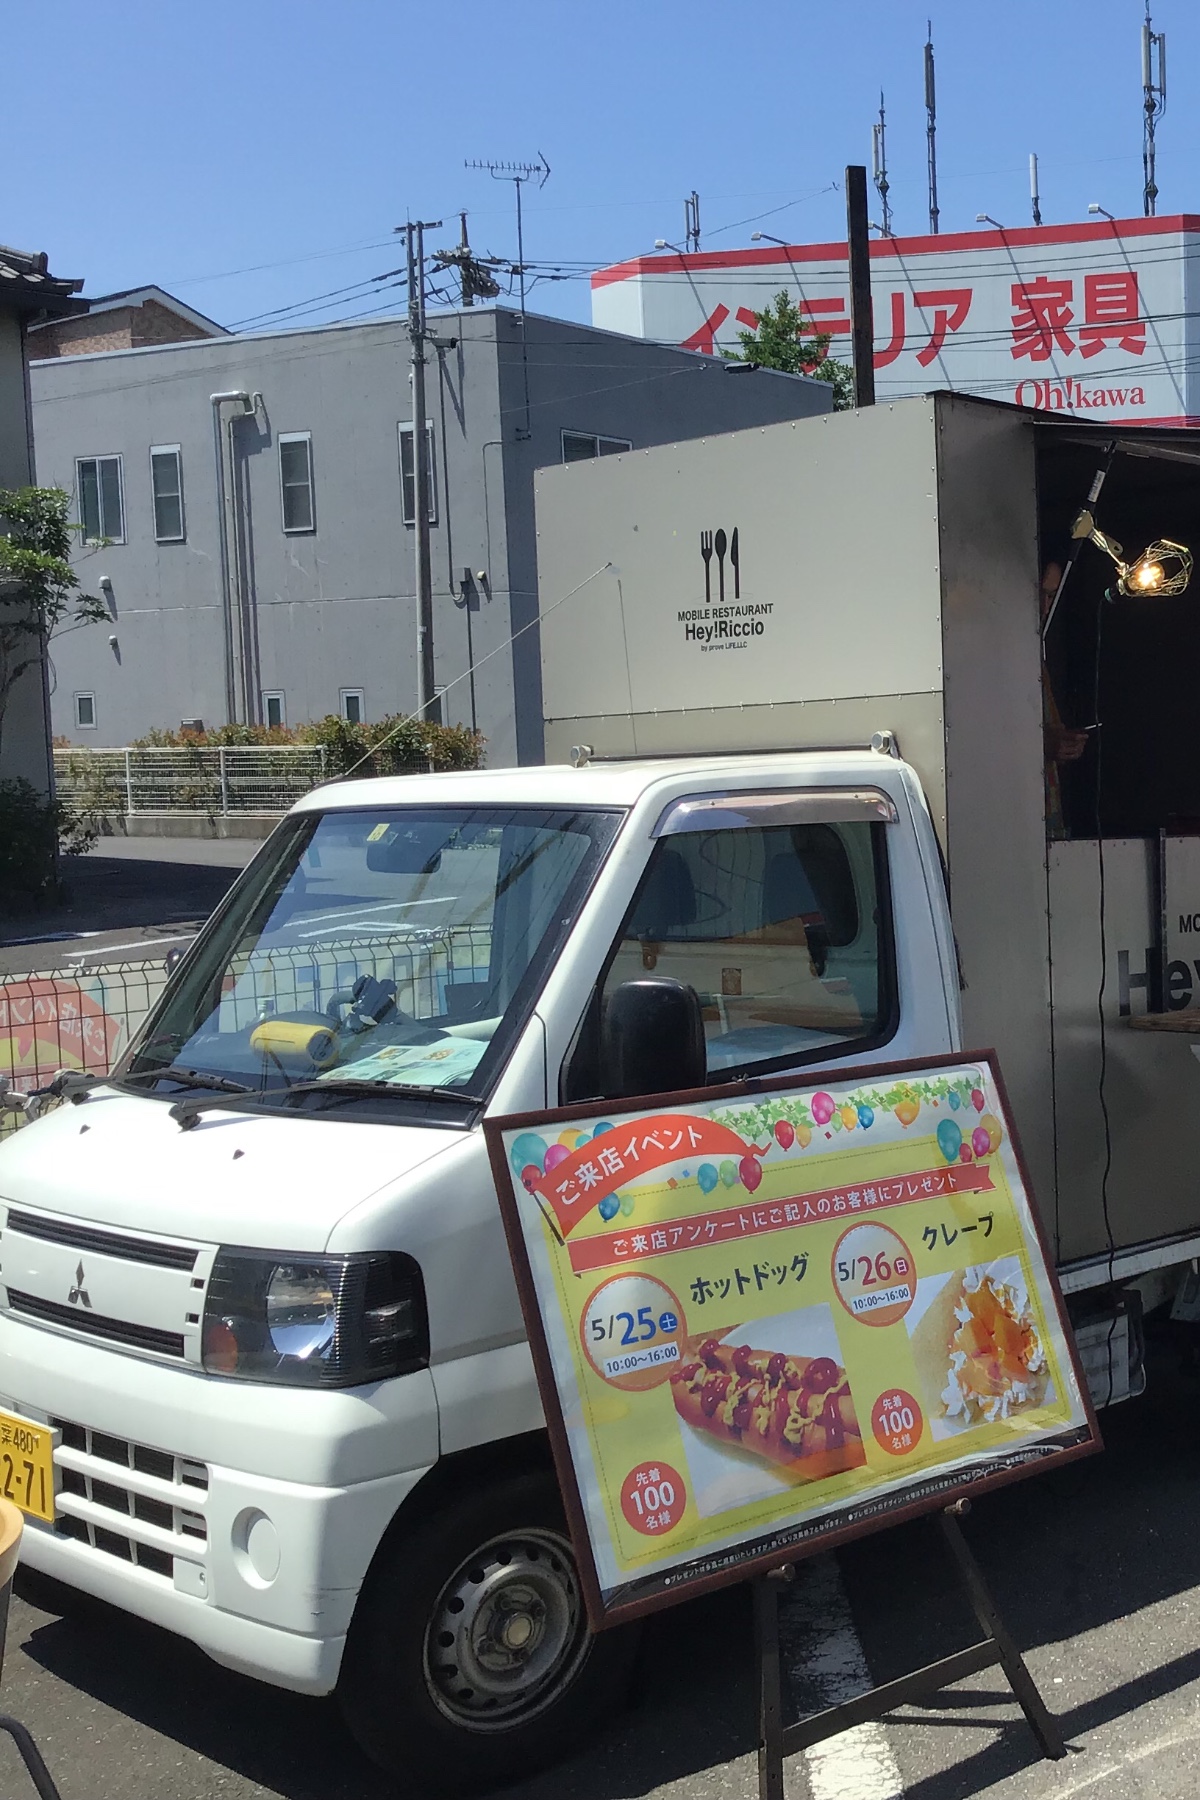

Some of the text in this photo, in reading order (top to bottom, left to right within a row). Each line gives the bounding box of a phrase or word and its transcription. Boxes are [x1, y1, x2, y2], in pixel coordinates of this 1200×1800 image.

[1010, 271, 1147, 361] 家具
[1015, 375, 1146, 411] Oh!kawa
[678, 603, 773, 621] MOBILE RESTAURANT
[685, 618, 764, 642] Hey!Riccio
[555, 1125, 703, 1206] ご来店イベント
[612, 1172, 957, 1257] ご来店アンケートにご記入のお客様にプレゼント
[922, 1211, 994, 1250] クレープ
[690, 1251, 809, 1305] ホットドッグ
[882, 1394, 902, 1410] 先着
[878, 1407, 914, 1437] 100
[892, 1435, 912, 1449] 名様
[0, 1453, 46, 1513] 2-71
[635, 1467, 661, 1487] 先着
[630, 1481, 675, 1516] 100
[645, 1510, 671, 1529] 名様
